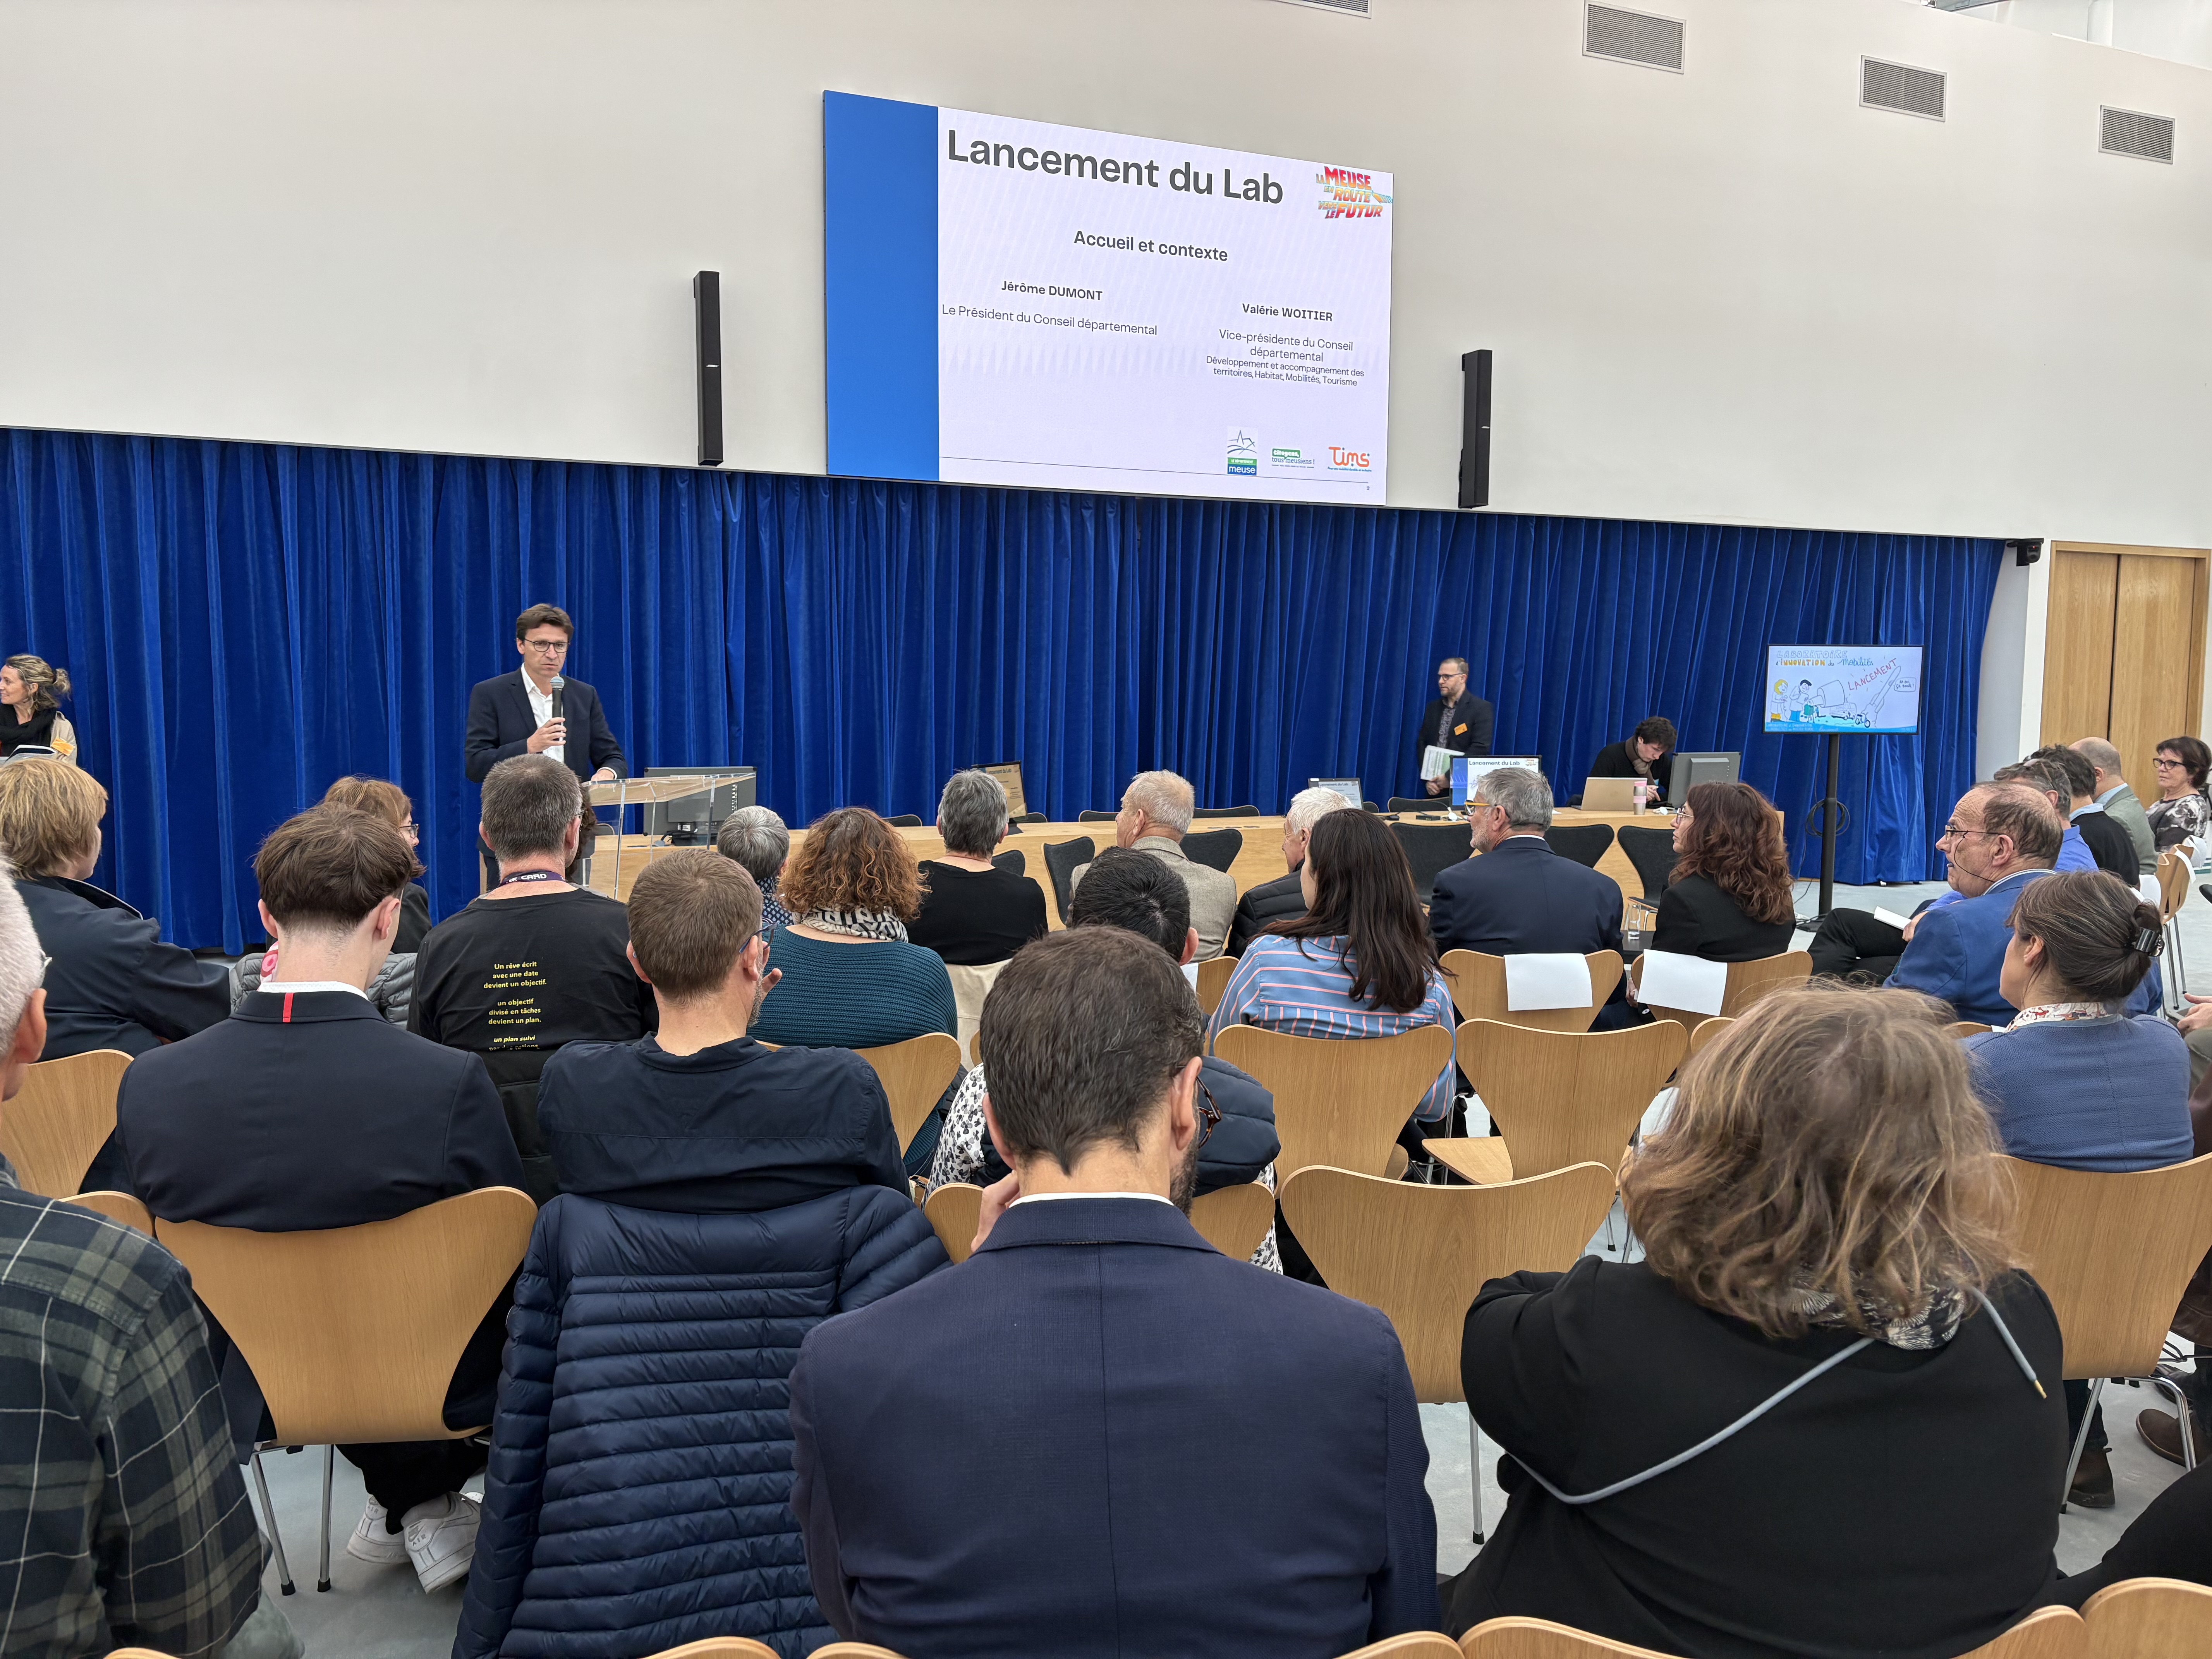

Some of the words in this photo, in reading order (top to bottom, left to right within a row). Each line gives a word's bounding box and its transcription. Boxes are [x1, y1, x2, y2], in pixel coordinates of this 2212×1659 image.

[949, 129, 1159, 188] Lancement
[1169, 161, 1212, 195] du
[1224, 169, 1283, 204] Lab
[1316, 173, 1325, 184] LA
[1324, 166, 1372, 191] MEUSE
[1333, 187, 1371, 203] ROUTE
[1318, 201, 1337, 210] VERS
[1325, 210, 1336, 219] LE
[1335, 202, 1383, 219] FUTUR
[1073, 230, 1134, 251] Accueil
[1138, 240, 1154, 253] et
[1158, 243, 1228, 261] contexte
[1001, 281, 1046, 294] Jérôme
[1049, 285, 1103, 301] DUMONT
[942, 304, 956, 315] Le
[958, 306, 1014, 321] Président
[1017, 312, 1030, 323] du
[1034, 314, 1075, 327] Conseil
[1077, 318, 1157, 336] départemental
[1242, 303, 1279, 316] Valérie
[1281, 307, 1333, 321] WOITIER
[1219, 329, 1300, 346] Vice-présidente
[1302, 337, 1315, 347] du
[1317, 338, 1353, 351] Conseil
[1250, 346, 1323, 362] départemental
[1206, 356, 1269, 369] Développement
[1280, 363, 1349, 376] accompagnement
[1350, 369, 1364, 377] des
[1213, 368, 1254, 379] territoires,
[1255, 371, 1284, 381] Habitat,
[1286, 373, 1321, 385] Mobilités,
[1322, 376, 1357, 386] Tourisme
[1776, 650, 1848, 659] LABORATOIRE
[1848, 658, 1896, 690] LANCEMENT
[520, 979, 547, 988] objectif.
[508, 998, 534, 1007] objectif
[412, 1534, 426, 1547] AIR
